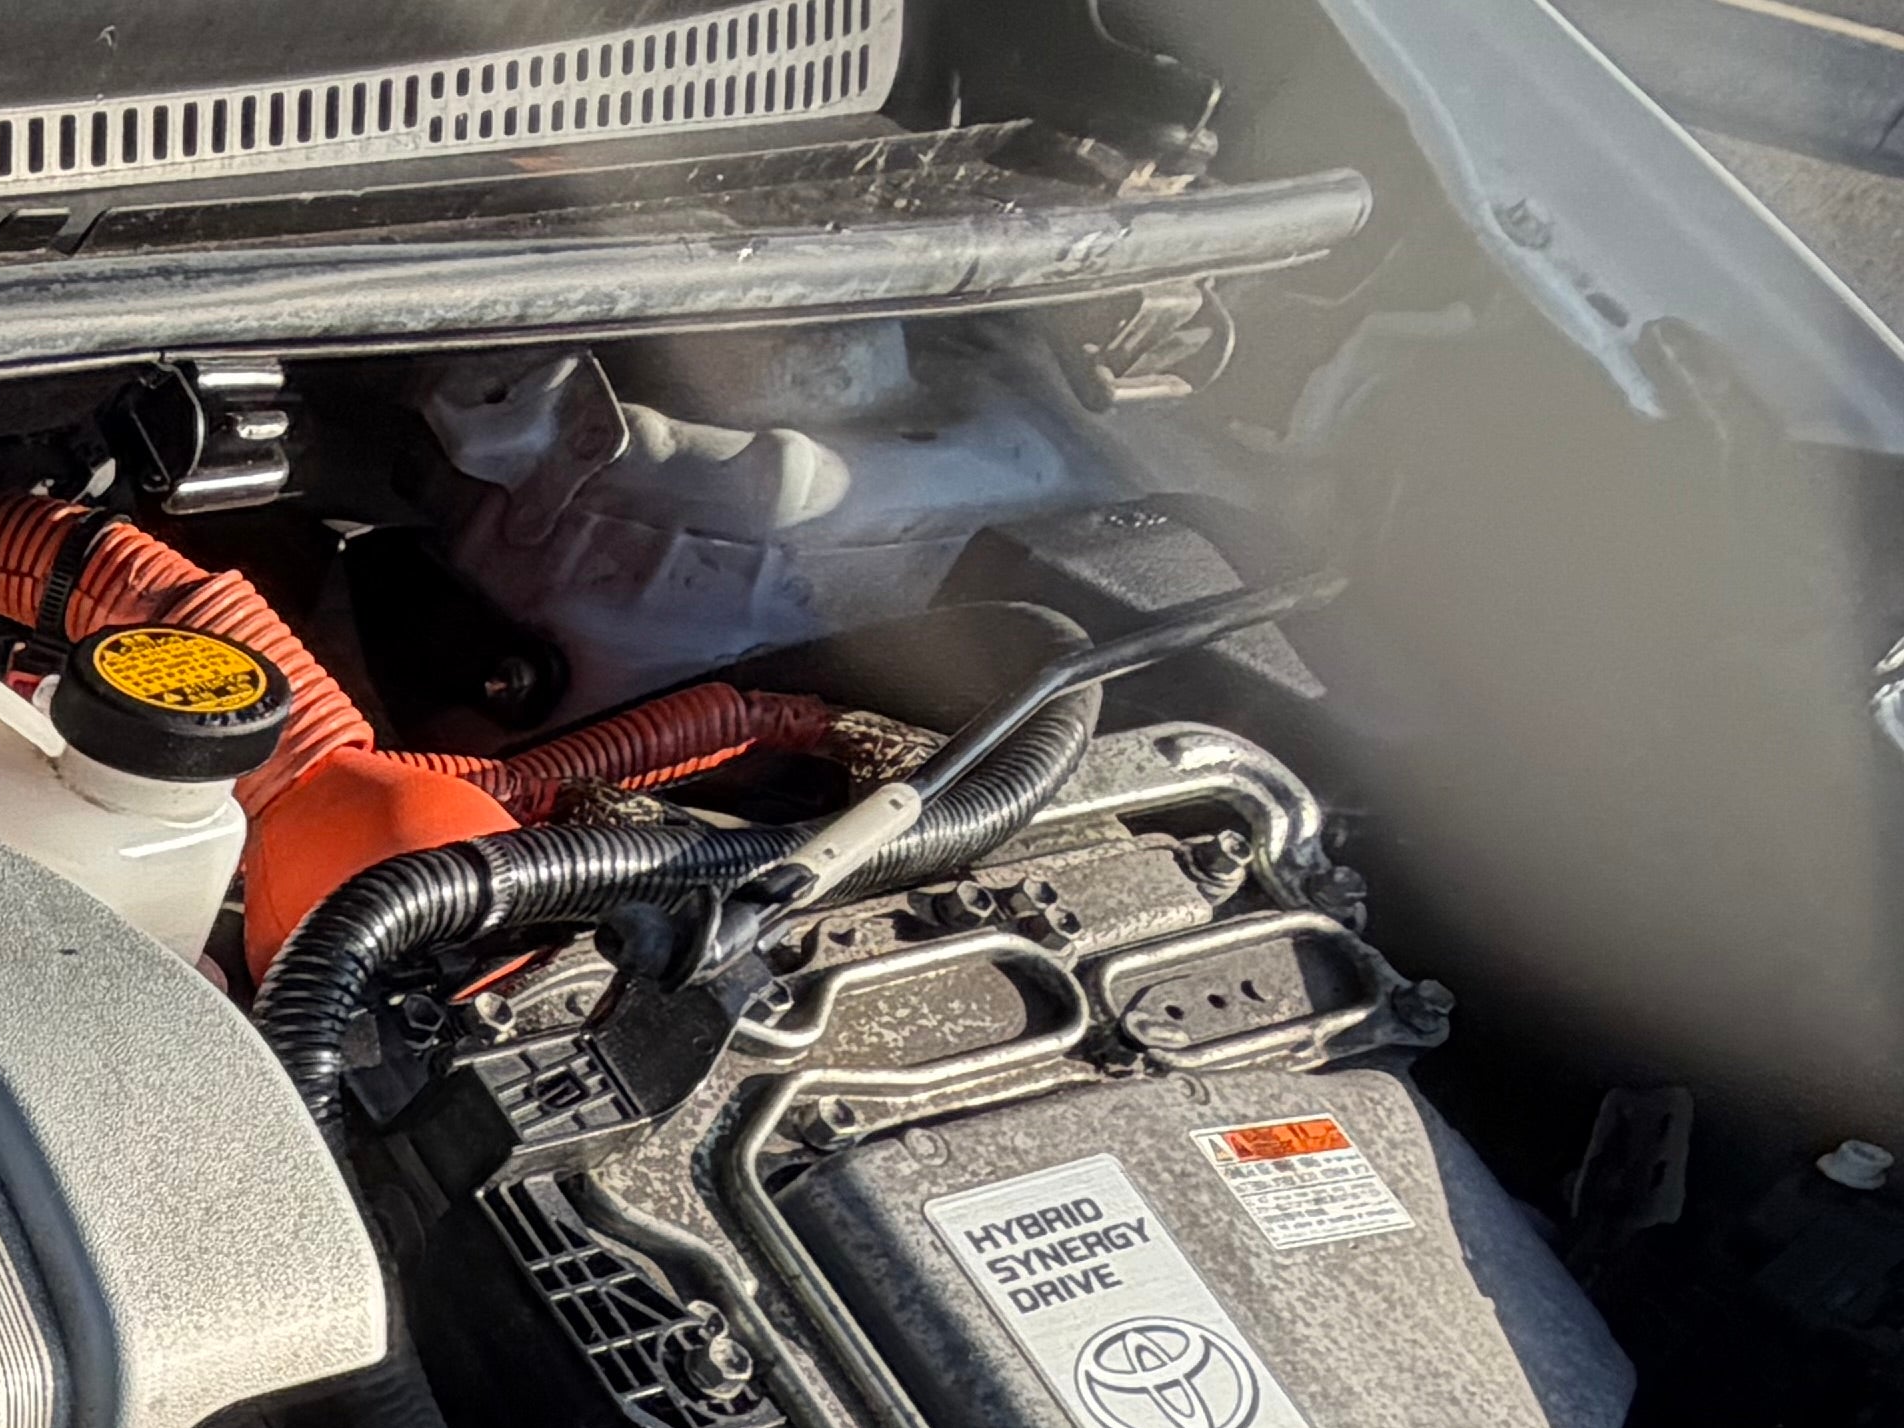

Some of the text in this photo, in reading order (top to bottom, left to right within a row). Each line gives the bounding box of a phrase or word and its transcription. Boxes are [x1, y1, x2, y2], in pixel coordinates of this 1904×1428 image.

[964, 1198, 1103, 1253] HYBRID
[987, 1217, 1151, 1284] SYNERGY
[1007, 1263, 1123, 1314] DRIVE
